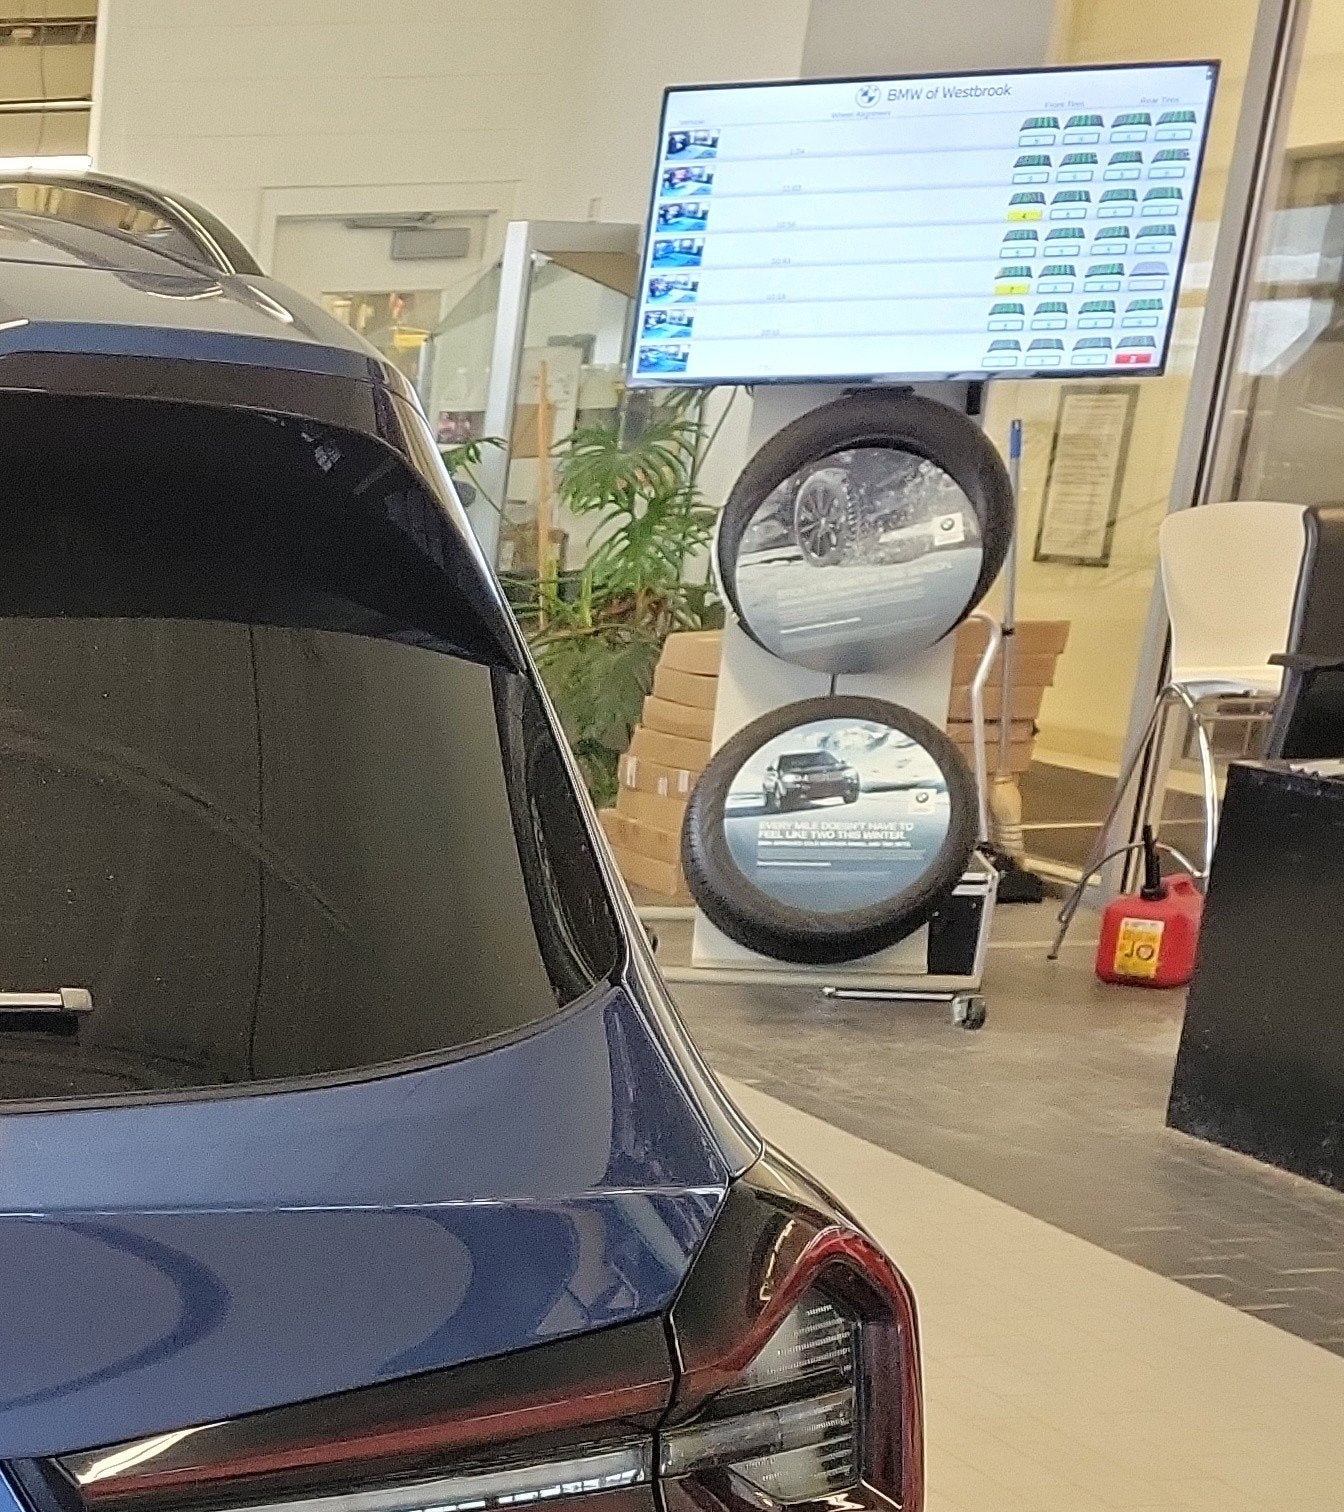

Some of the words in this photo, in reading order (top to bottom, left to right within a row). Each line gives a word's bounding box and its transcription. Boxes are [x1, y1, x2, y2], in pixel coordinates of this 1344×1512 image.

[887, 87, 923, 101] BMW
[926, 87, 939, 100] of
[942, 84, 1012, 99] Westbrook
[758, 830, 783, 839] FEEL
[785, 830, 808, 839] LIKE
[811, 831, 836, 839] TWO
